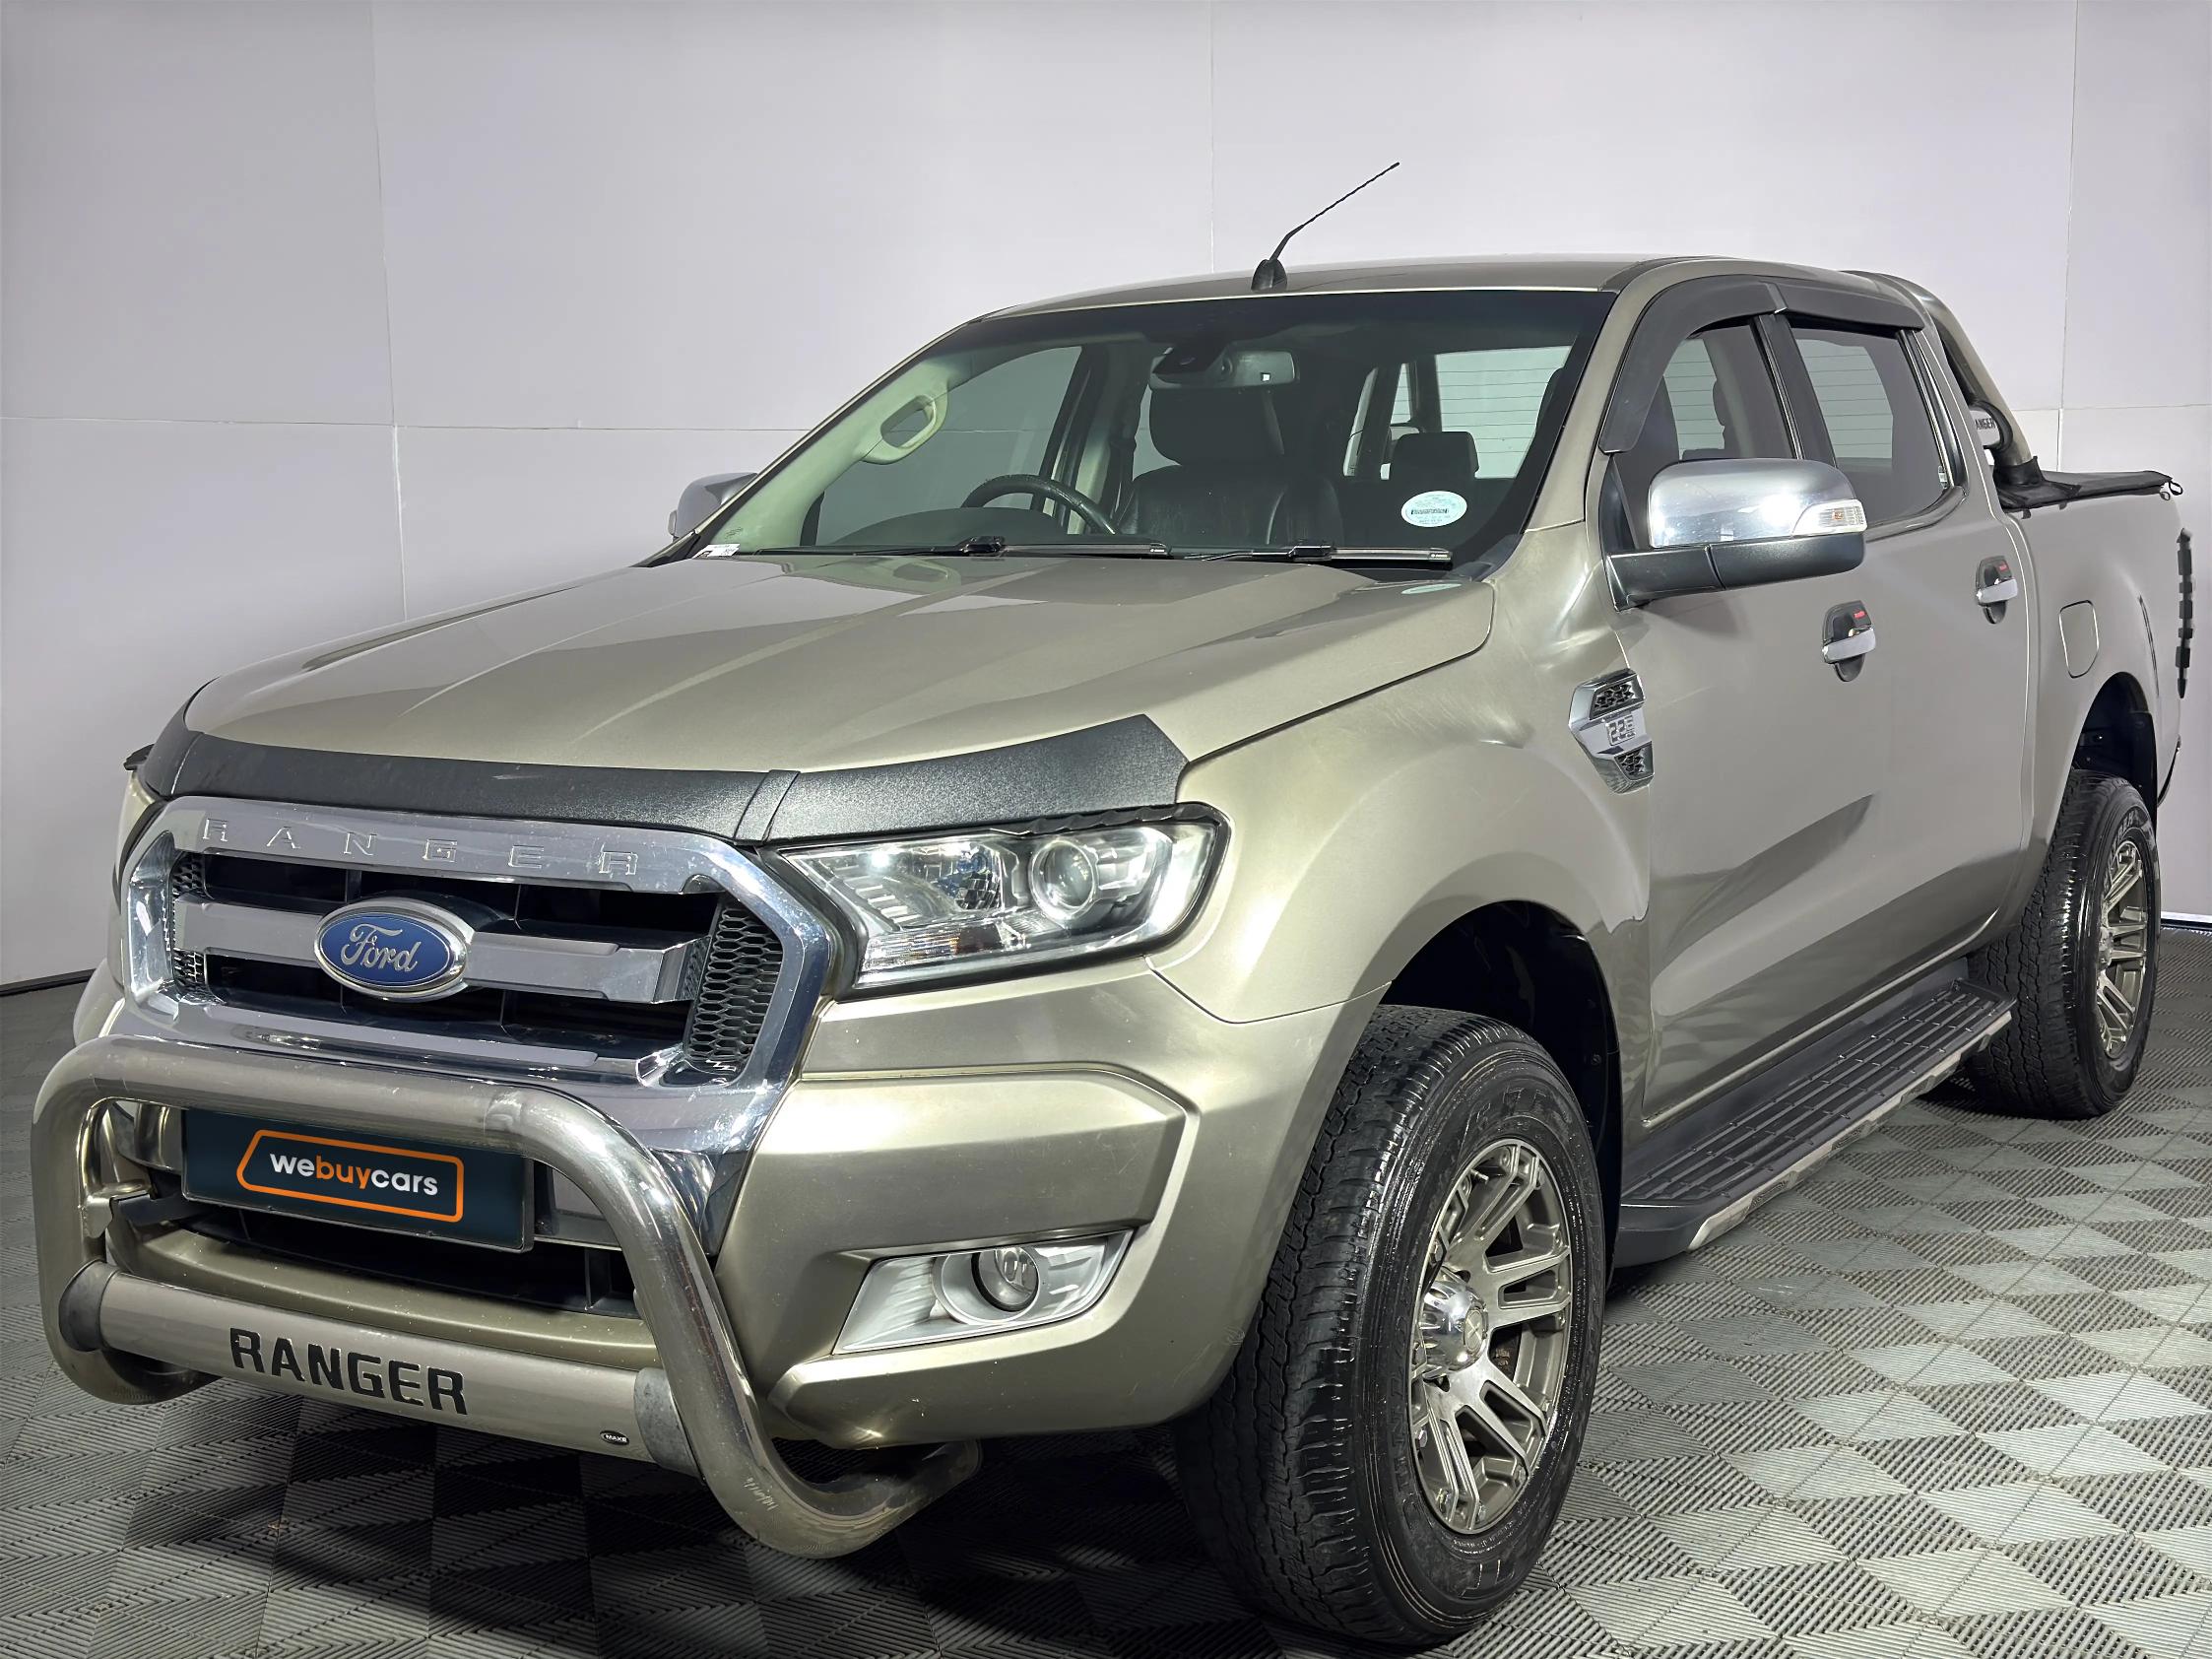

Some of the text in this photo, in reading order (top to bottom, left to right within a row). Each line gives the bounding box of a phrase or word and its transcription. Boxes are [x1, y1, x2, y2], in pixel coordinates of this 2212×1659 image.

[202, 817, 638, 875] RANGER
[340, 922, 419, 972] Ford
[269, 1150, 439, 1196] webuycars
[229, 1327, 468, 1416] RANGER
